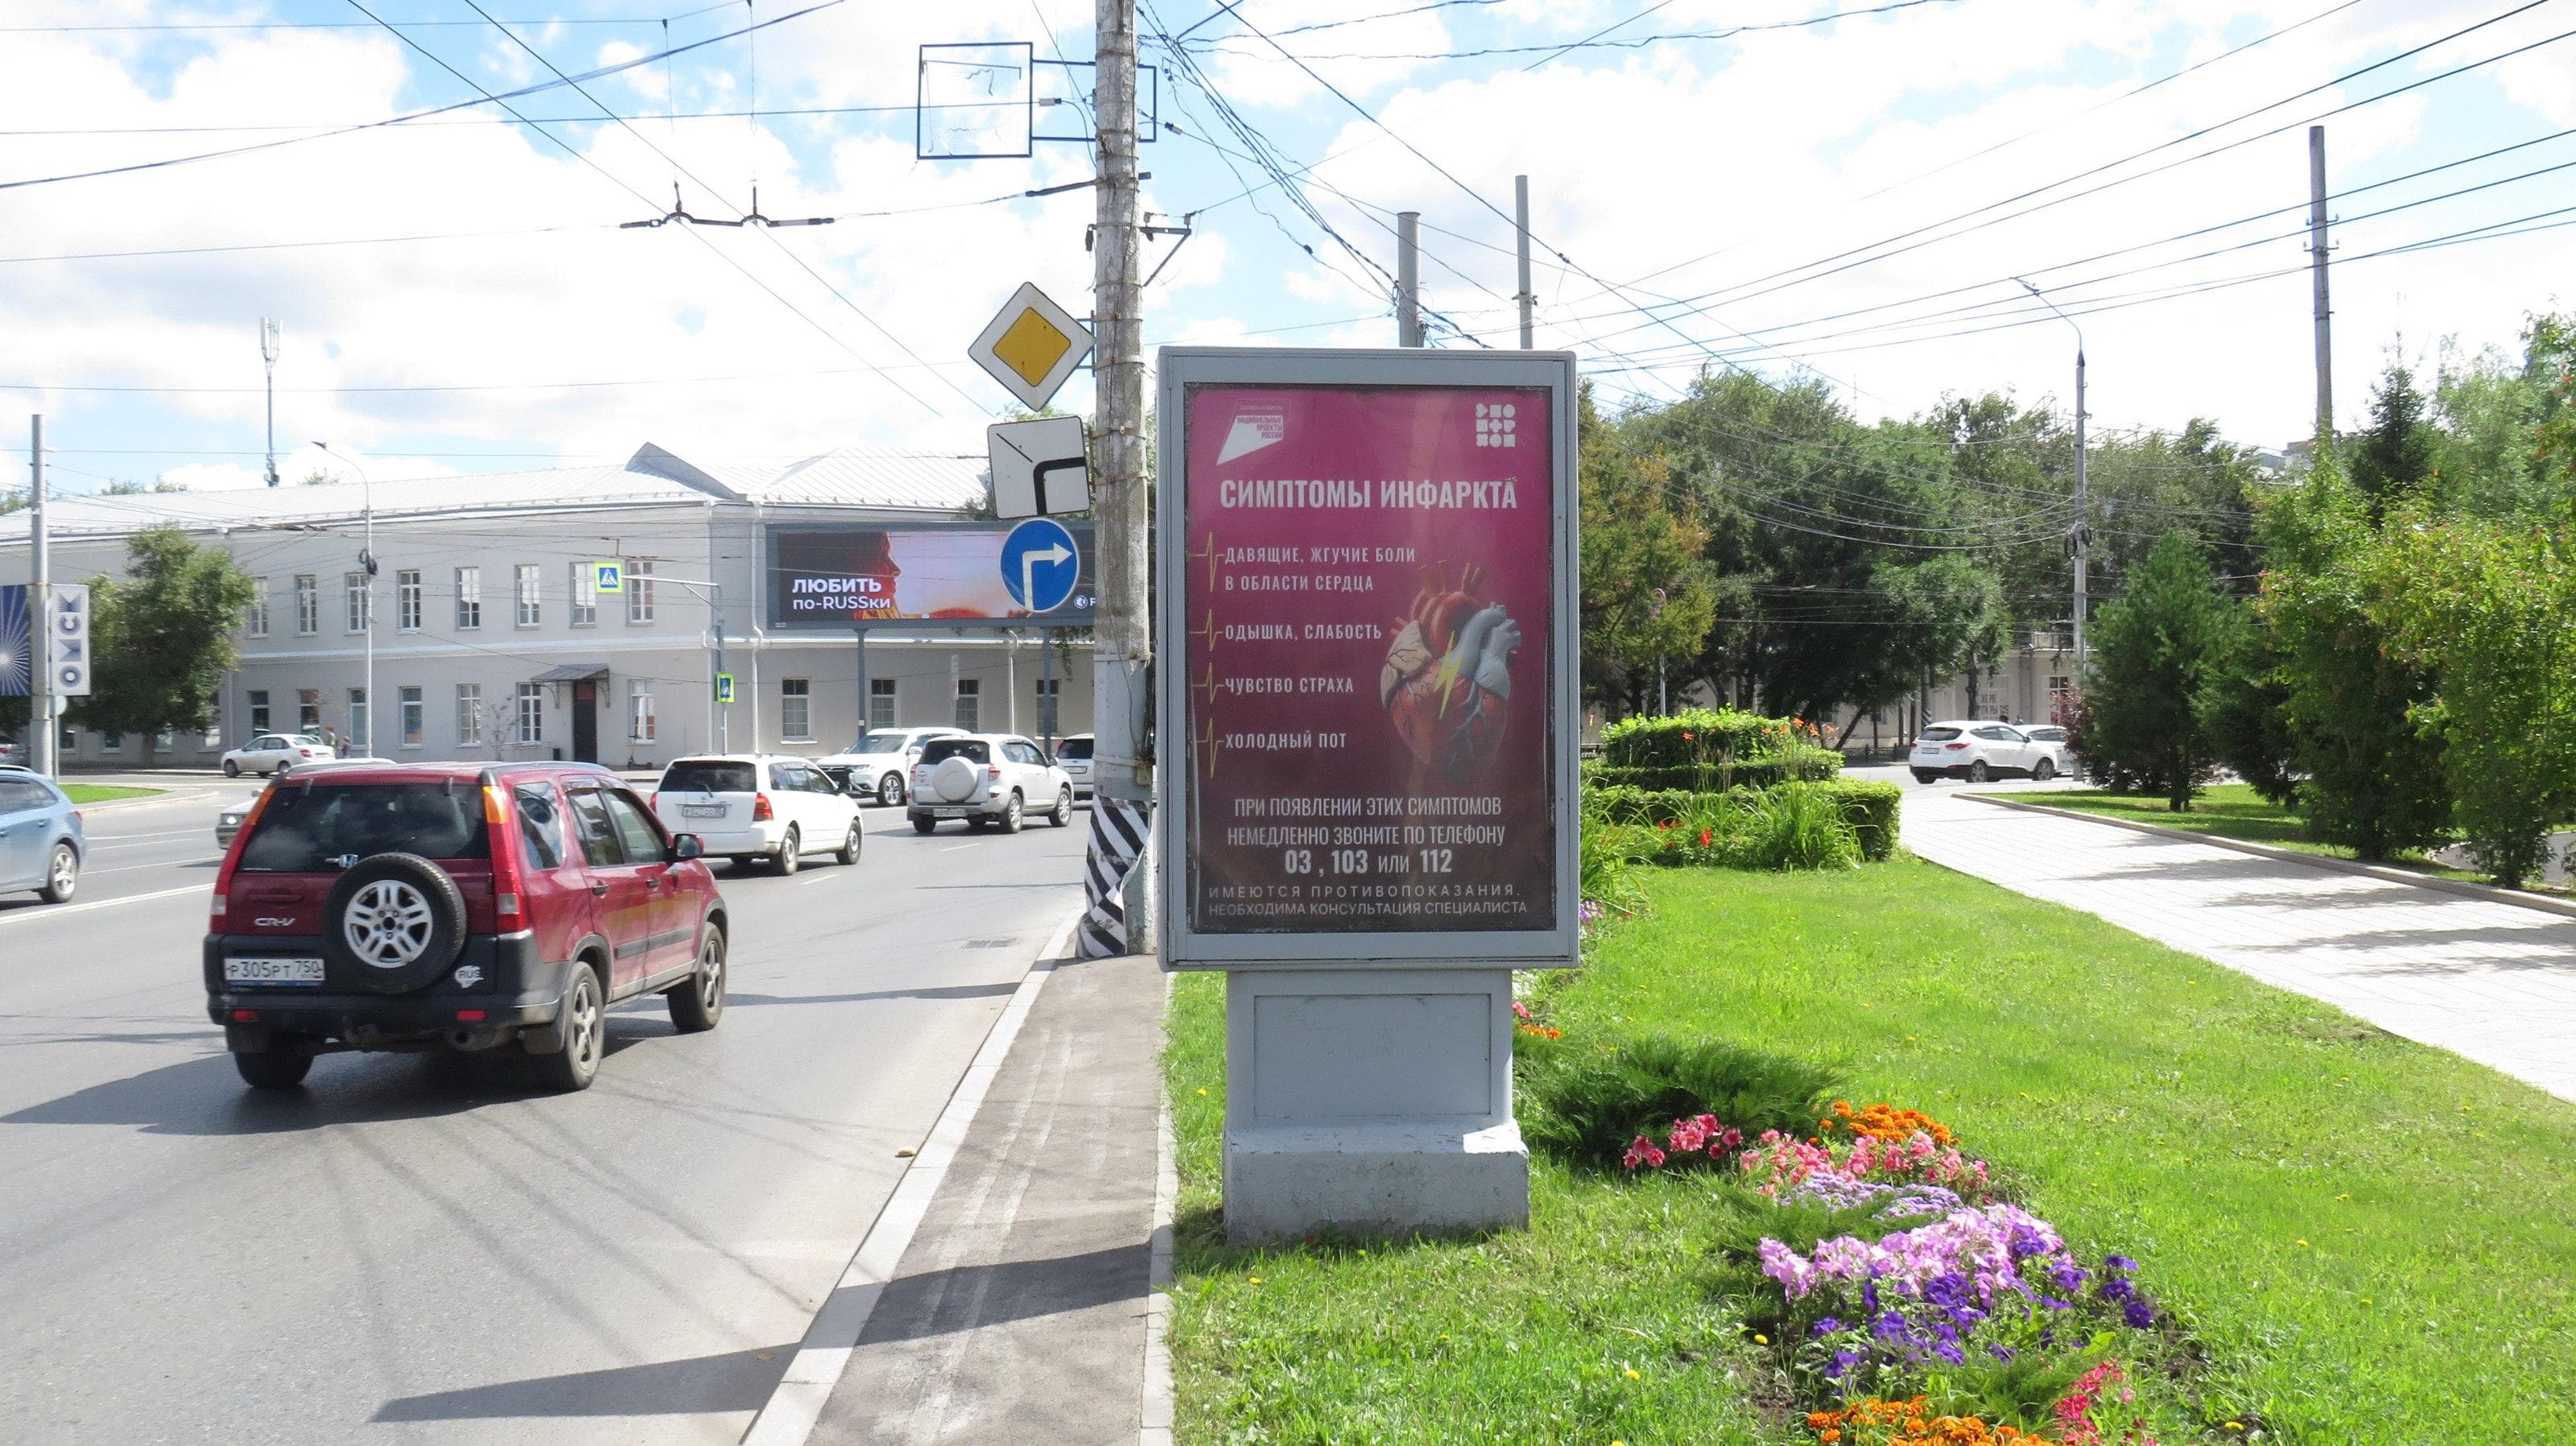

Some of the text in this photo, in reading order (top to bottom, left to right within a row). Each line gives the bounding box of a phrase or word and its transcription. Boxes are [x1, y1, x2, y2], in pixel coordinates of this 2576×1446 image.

[1220, 479, 1518, 510] СИМПТОМЫ ИНФАРКТА
[1224, 547, 1416, 565] ДАВЯЩИЕ, ЖГУЧИЕ БОЛИ
[791, 578, 882, 593] ЛЮБИТЬ
[1224, 575, 1373, 593] В ОБЛАСТИ СЕРДЦА
[793, 596, 890, 609] по-RUSSки
[1224, 624, 1383, 642] ОДЫШКА, СЛАБОСТЬ
[1224, 677, 1354, 696] ЧУВСТВО СТРАХА
[1224, 729, 1347, 750] ХОЛОДНЫЙ ПОТ
[1234, 795, 1503, 817] ПРИ ПОЯВЛЕНИИ ЭТИХ СИМПТОМОВ
[1227, 824, 1506, 848] НЕМЕДЛЕННО ЗВОНИТЕ ПО ТЕЛЕФОНУ
[1331, 849, 1368, 874] 103
[1377, 854, 1410, 874] ИЛИ
[1419, 849, 1453, 874] 112
[1208, 884, 1521, 899] ИМЕЮТСЯ ПРОТИВОПОКАЗАНИЯ.
[1208, 901, 1528, 917] НЕОБХОДИМА КОНСУЛЬТАЦИЯ СПЕЦИАЛИСТА
[254, 917, 295, 927] CR-V
